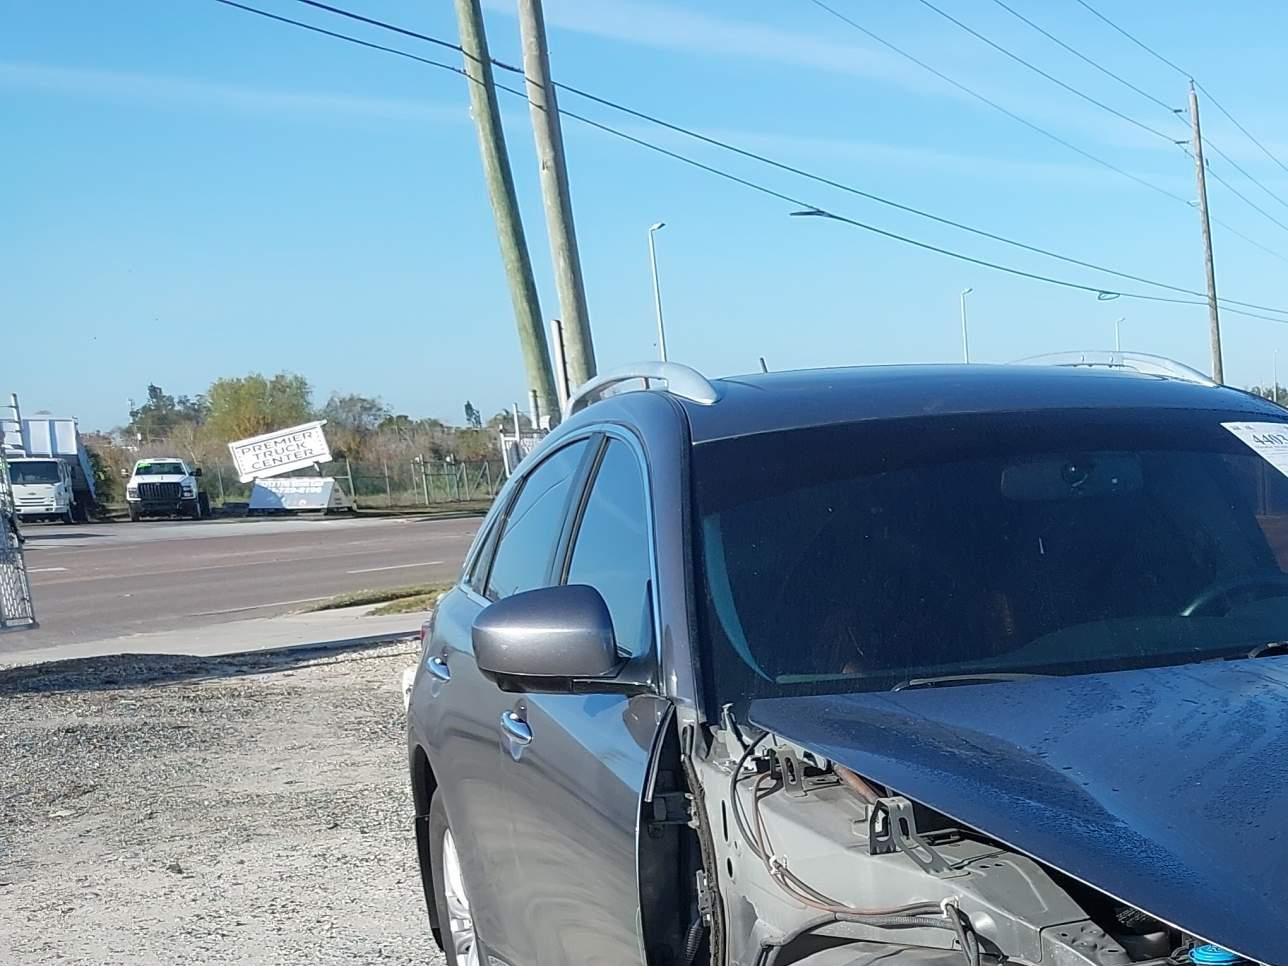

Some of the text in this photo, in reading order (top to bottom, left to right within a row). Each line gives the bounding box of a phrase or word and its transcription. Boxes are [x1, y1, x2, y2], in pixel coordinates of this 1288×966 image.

[241, 431, 313, 455] PREMIER
[252, 441, 306, 461] TRUCK
[252, 448, 314, 470] CENTER
